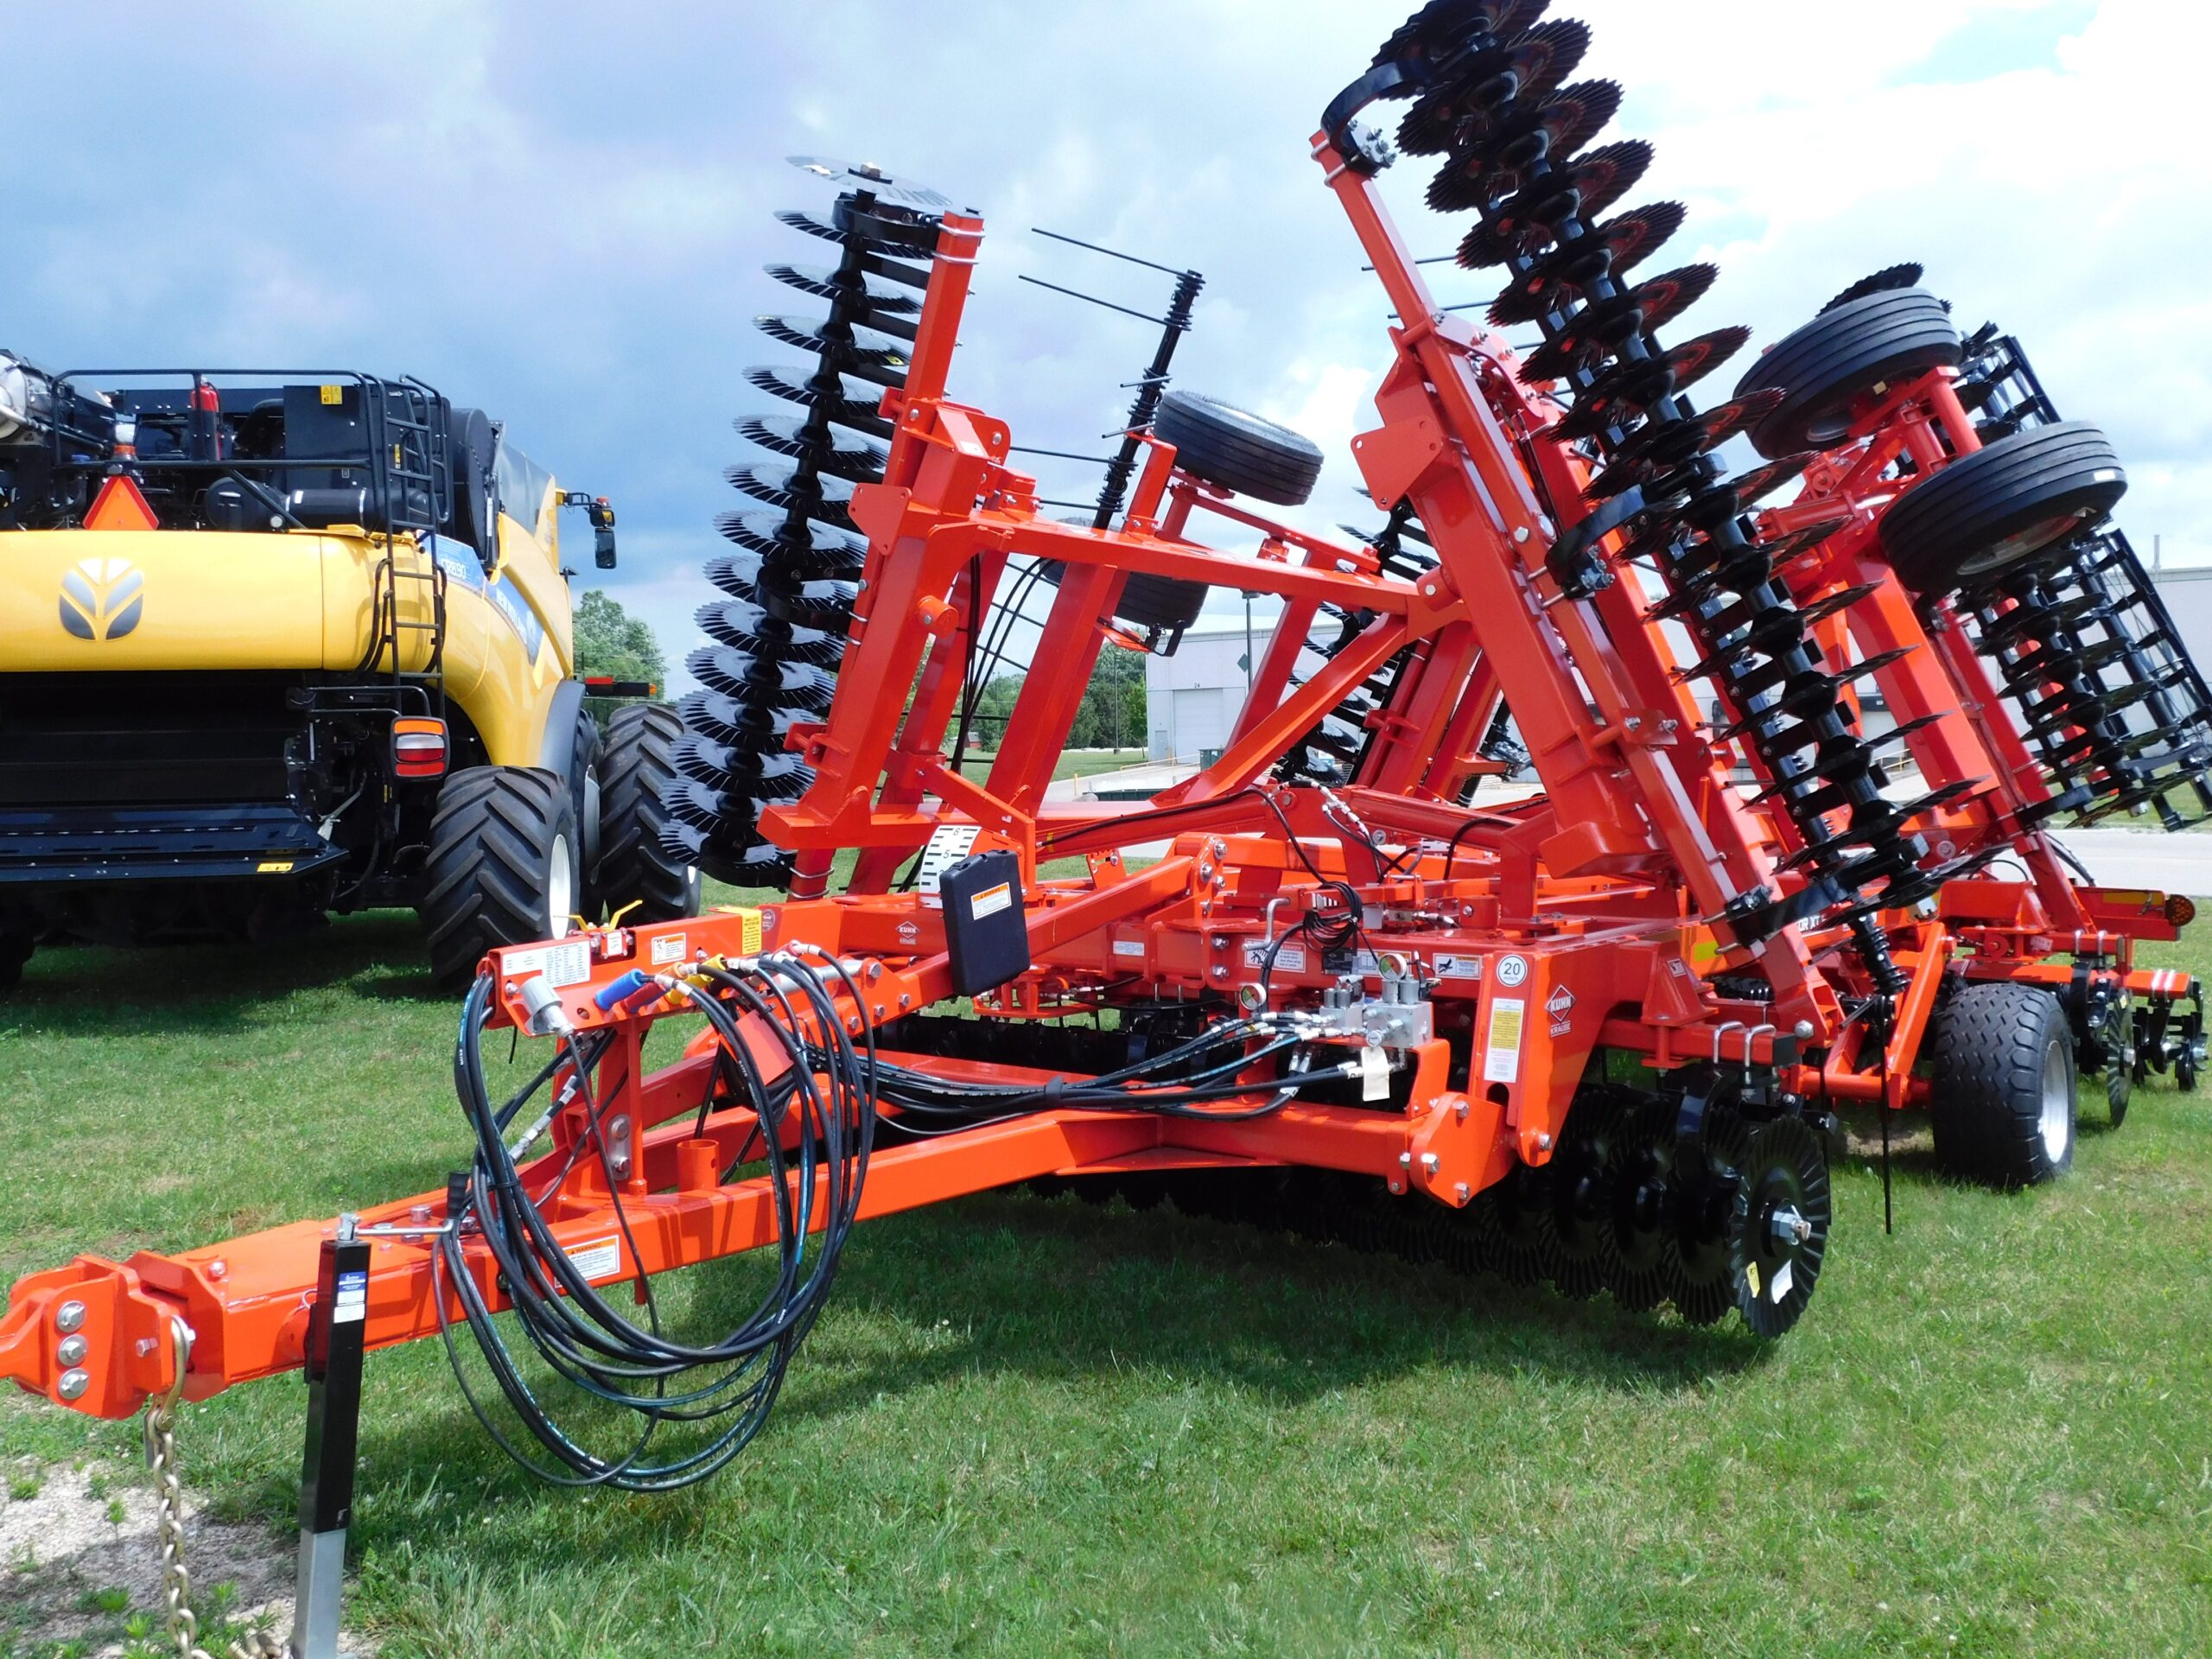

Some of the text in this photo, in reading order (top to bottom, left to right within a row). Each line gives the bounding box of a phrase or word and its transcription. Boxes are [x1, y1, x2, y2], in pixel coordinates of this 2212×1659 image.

[952, 827, 961, 836] 6
[943, 849, 951, 859] 5
[1503, 962, 1521, 976] 20
[1550, 995, 1572, 1012] KUHN
[1550, 1023, 1571, 1036] KRAUSE
